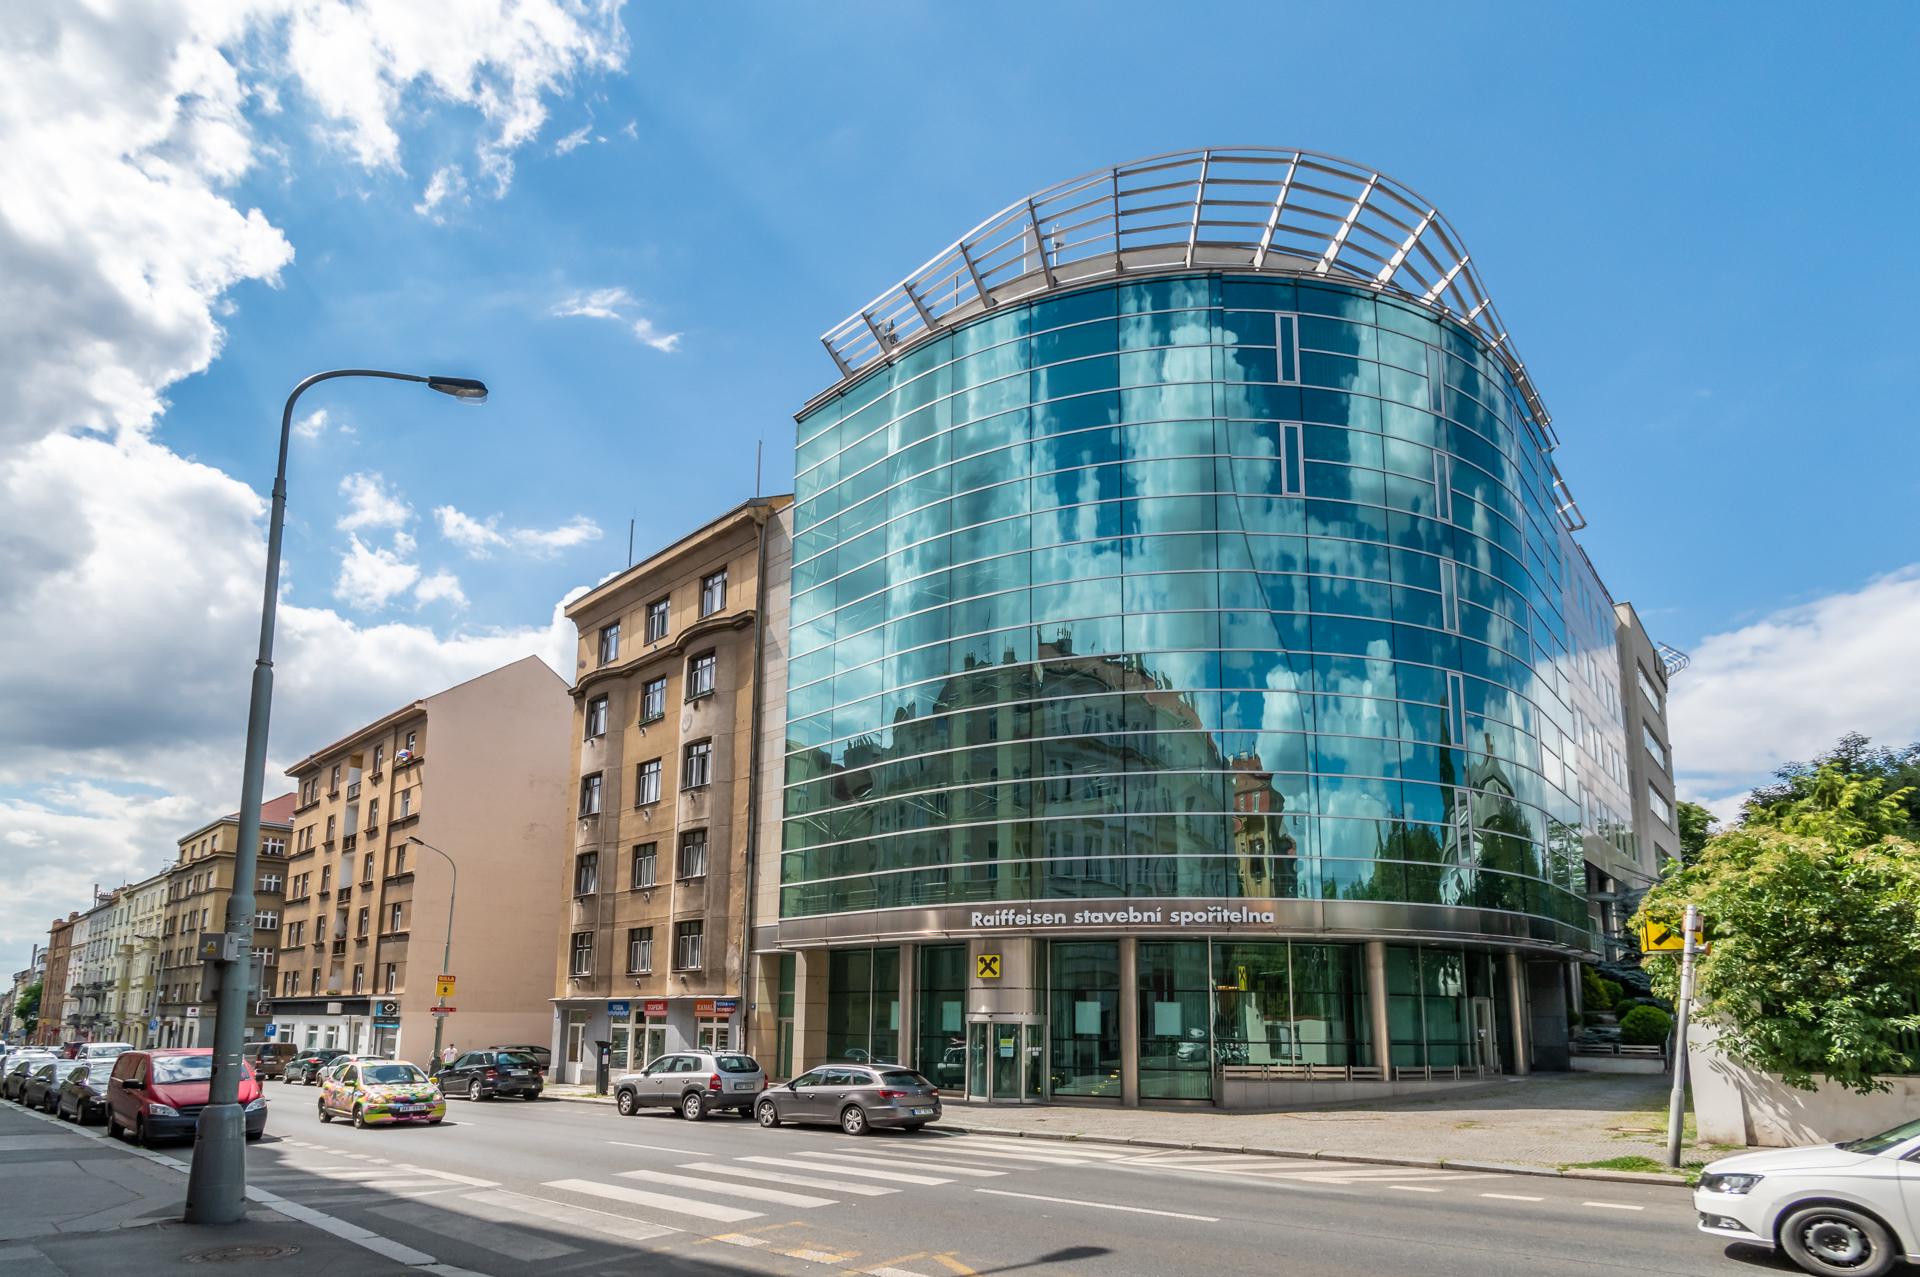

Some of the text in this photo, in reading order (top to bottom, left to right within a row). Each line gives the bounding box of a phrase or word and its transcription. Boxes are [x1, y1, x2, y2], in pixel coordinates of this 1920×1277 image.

[971, 906, 1274, 927] Raiffeisen stavební spořitelna
[267, 1025, 274, 1033] P
